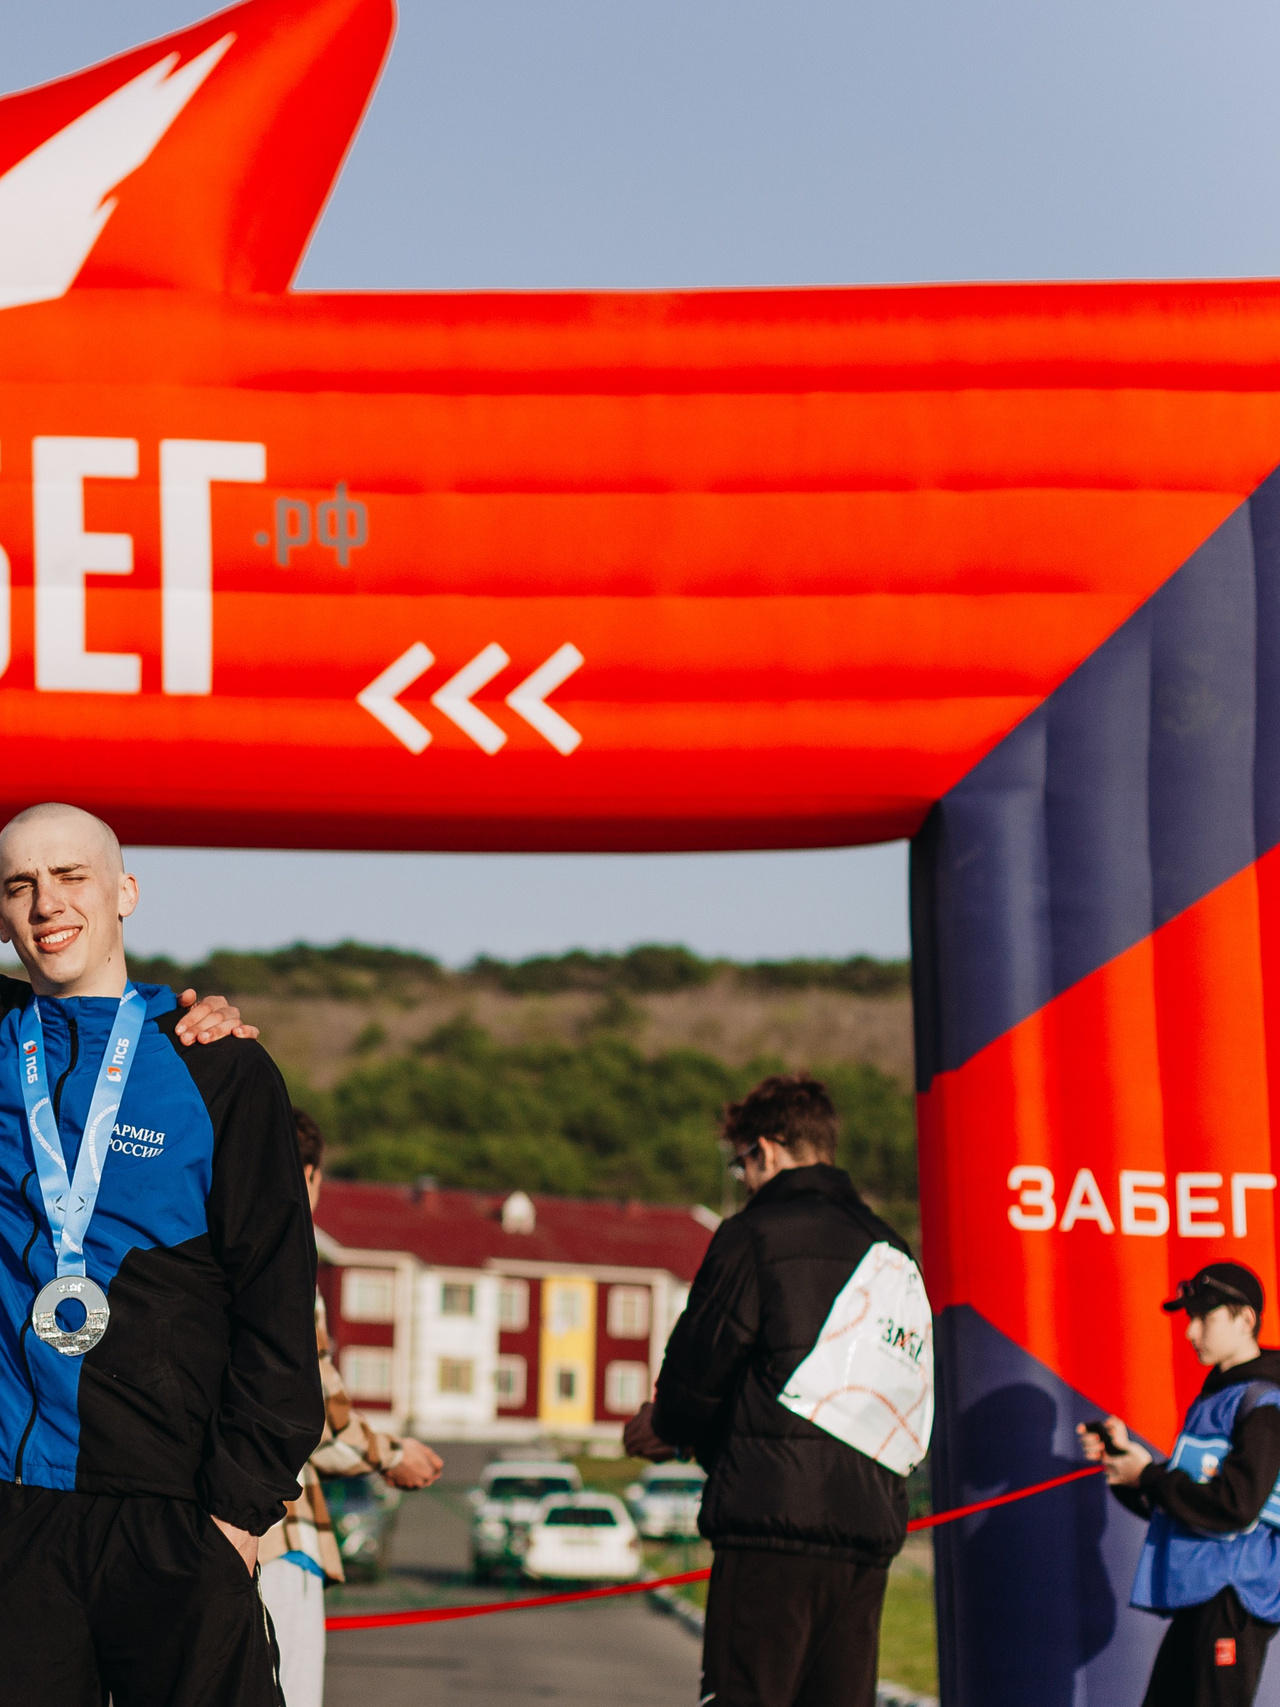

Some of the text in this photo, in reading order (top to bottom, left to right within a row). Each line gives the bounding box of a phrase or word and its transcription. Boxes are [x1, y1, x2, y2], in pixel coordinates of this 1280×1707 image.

[112, 1038, 130, 1065] ПСБ
[25, 1055, 39, 1085] ПСБ
[111, 1123, 166, 1146] АРМИЯ
[1007, 1164, 1278, 1239] ЗАБЕГ
